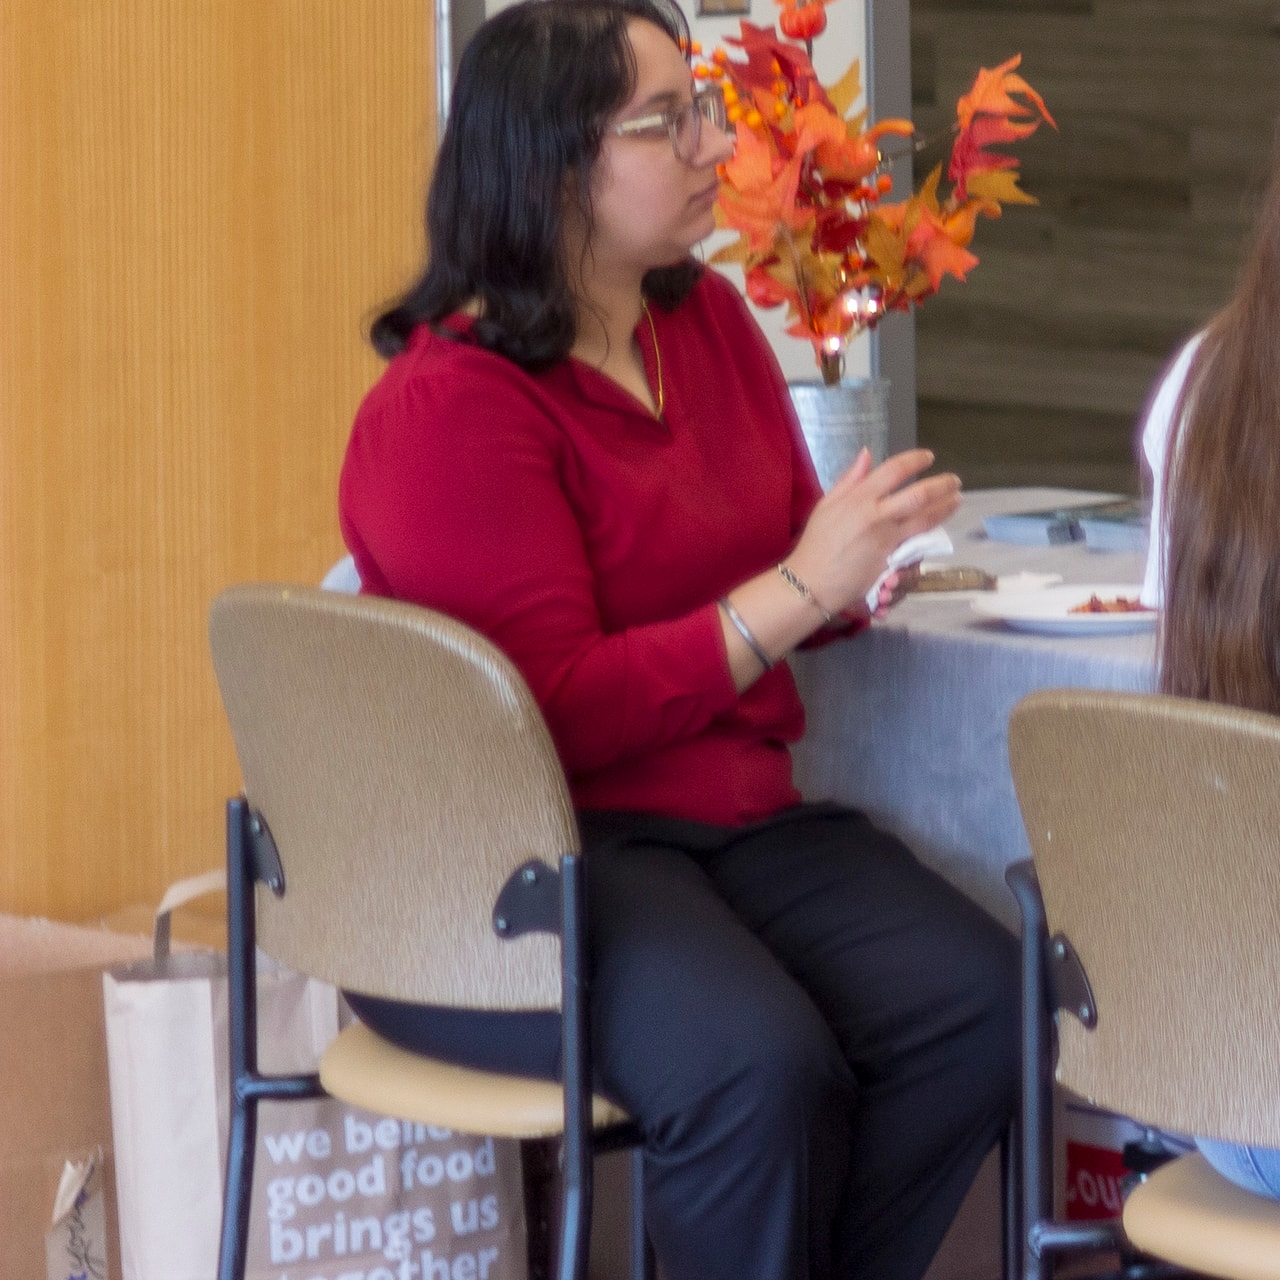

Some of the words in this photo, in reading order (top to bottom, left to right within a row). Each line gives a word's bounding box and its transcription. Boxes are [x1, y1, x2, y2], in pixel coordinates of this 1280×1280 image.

[263, 1128, 332, 1165] we
[266, 1154, 386, 1221] good
[401, 1137, 497, 1191] food
[269, 1210, 436, 1265] brings
[450, 1195, 500, 1236] us
